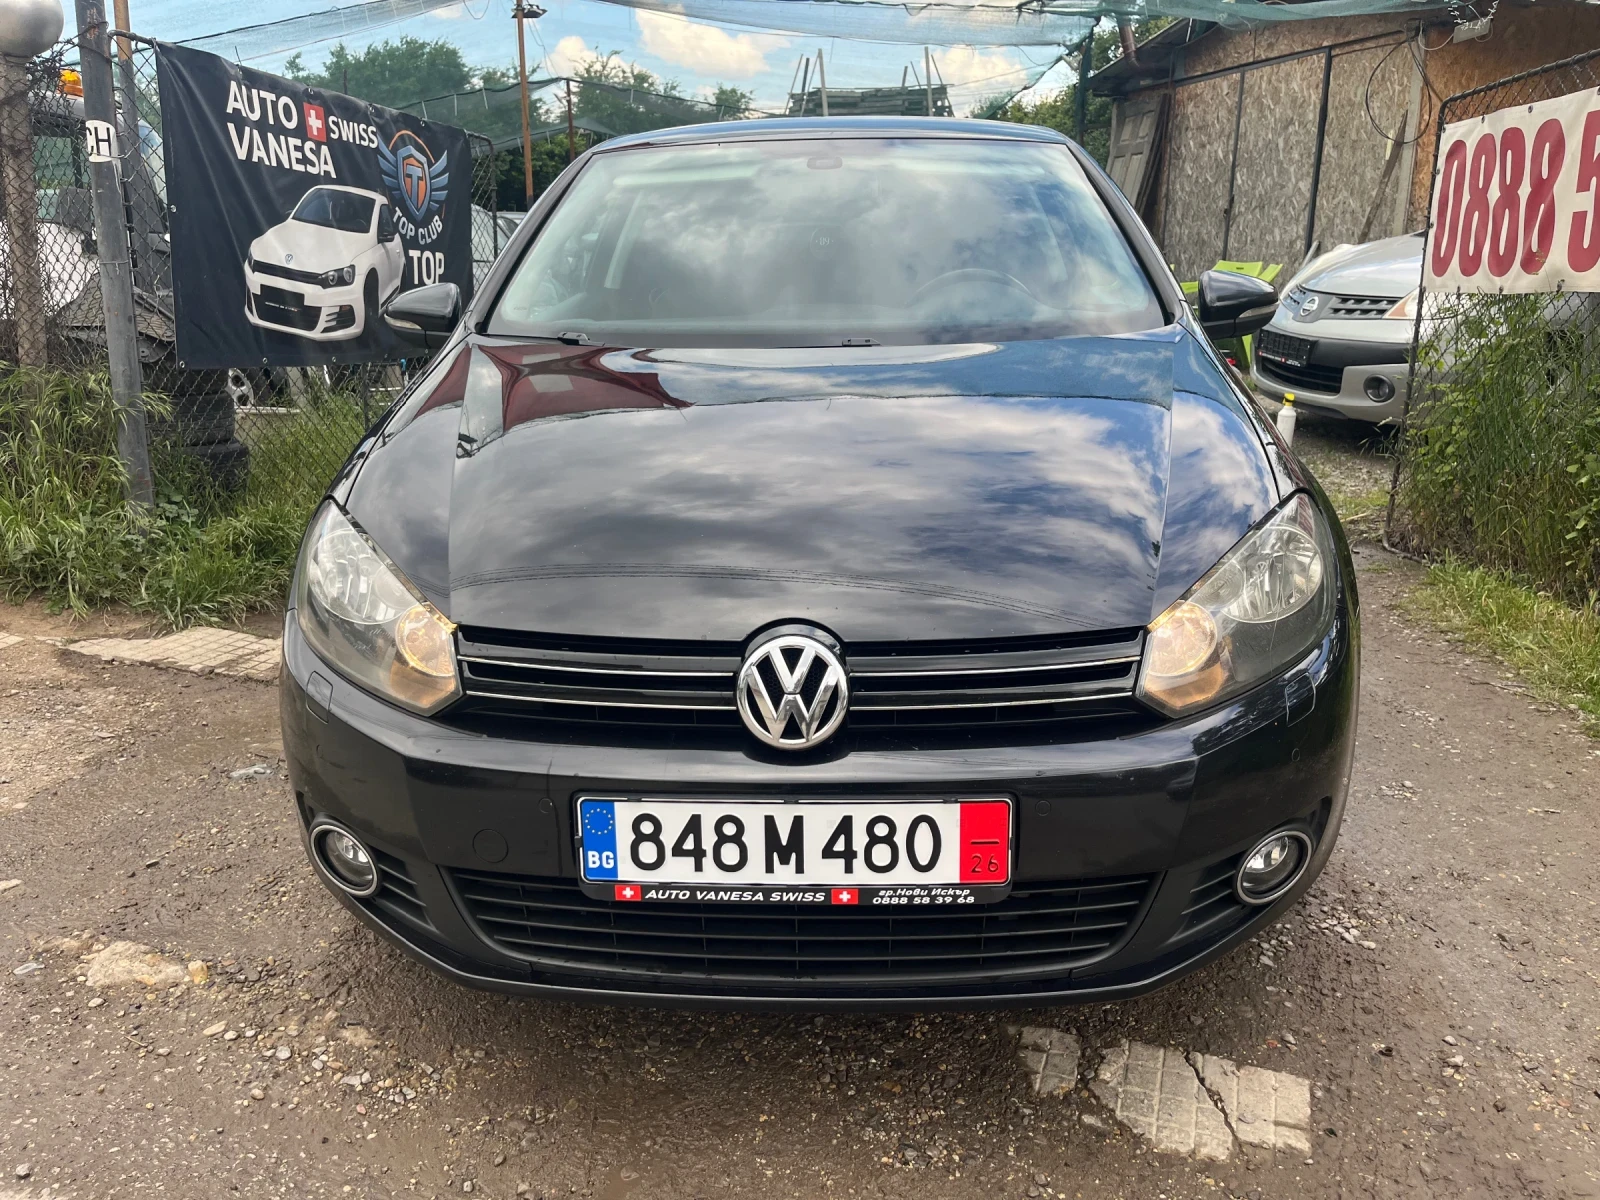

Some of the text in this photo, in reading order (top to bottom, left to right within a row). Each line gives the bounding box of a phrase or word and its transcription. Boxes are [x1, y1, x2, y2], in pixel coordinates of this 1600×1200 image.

[226, 80, 379, 149] AUTO SWISS
[227, 122, 337, 179] VANESA
[1431, 118, 1566, 277] 0888
[392, 206, 443, 245] TOP CLUB
[408, 249, 445, 285] TOP
[740, 638, 846, 748] VW
[587, 850, 615, 869] BG
[630, 812, 942, 875] 848 M 480
[970, 853, 999, 873] 26
[645, 889, 826, 902] AUTO VANESA SWISS
[872, 895, 975, 905] 0888 58 39 68
[931, 887, 970, 897] Искър
